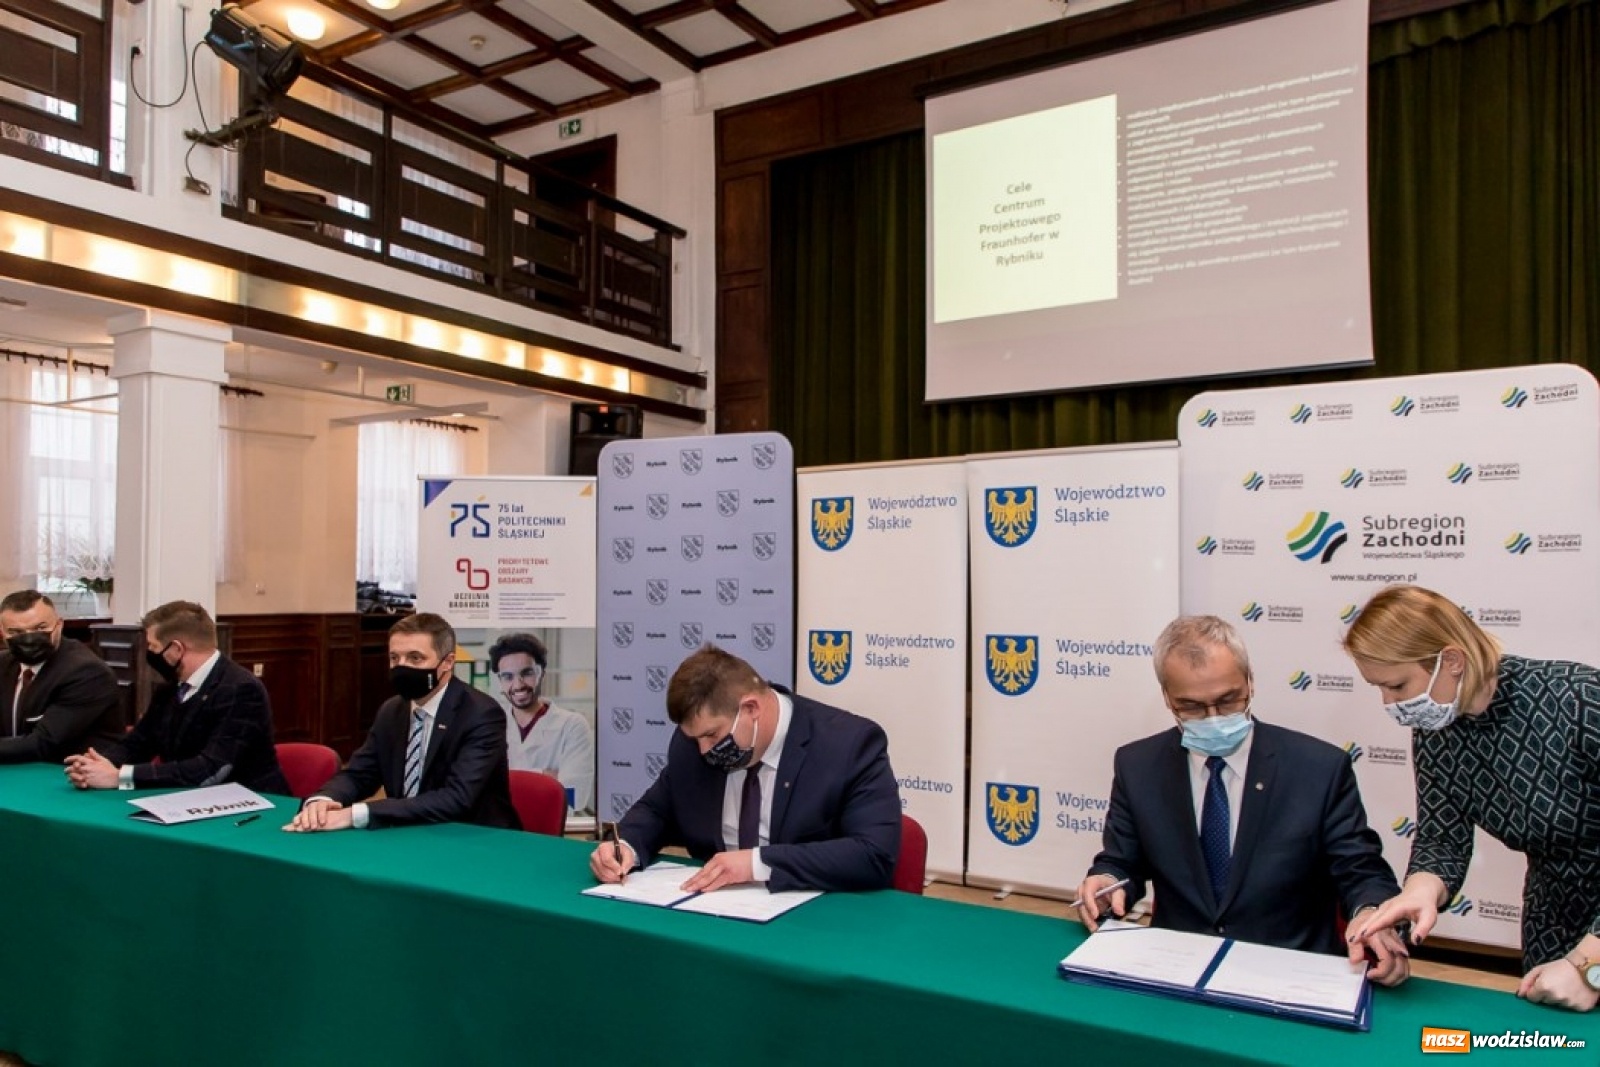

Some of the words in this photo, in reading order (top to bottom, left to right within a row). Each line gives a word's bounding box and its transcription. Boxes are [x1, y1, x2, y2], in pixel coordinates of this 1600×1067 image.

[1006, 182, 1032, 195] Cele
[994, 197, 1045, 214] Centrum
[979, 212, 1061, 234] Projektowego
[981, 231, 1045, 252] Fraunhofer
[1049, 231, 1060, 240] w
[996, 249, 1044, 267] Rybniku
[1534, 389, 1579, 400] Zachodni
[1478, 469, 1521, 478] Zachodni
[1054, 483, 1166, 504] Województwo
[498, 503, 510, 513] 75
[511, 503, 525, 513] lat
[867, 494, 958, 512] Województwo
[498, 516, 566, 526] POLITECHNIKI
[867, 513, 912, 531] Śląskie
[1054, 507, 1110, 527] Śląskie
[1362, 514, 1465, 532] Subregion
[498, 527, 545, 540] ŚLĄSKIEJ
[1362, 530, 1465, 547] Zachodni
[1537, 540, 1582, 548] Zachodni
[1363, 552, 1422, 561] Województwa
[1423, 550, 1465, 559] Śląskiego
[1331, 572, 1418, 582] www.subregion.pl
[865, 632, 955, 651] Województwo
[1055, 638, 1154, 657] Województw
[865, 652, 911, 670] Śląskie
[1055, 658, 1111, 679] Śląskie
[896, 776, 953, 793] wództwo
[186, 800, 259, 815] Rybnik
[1056, 810, 1105, 834] Śląski
